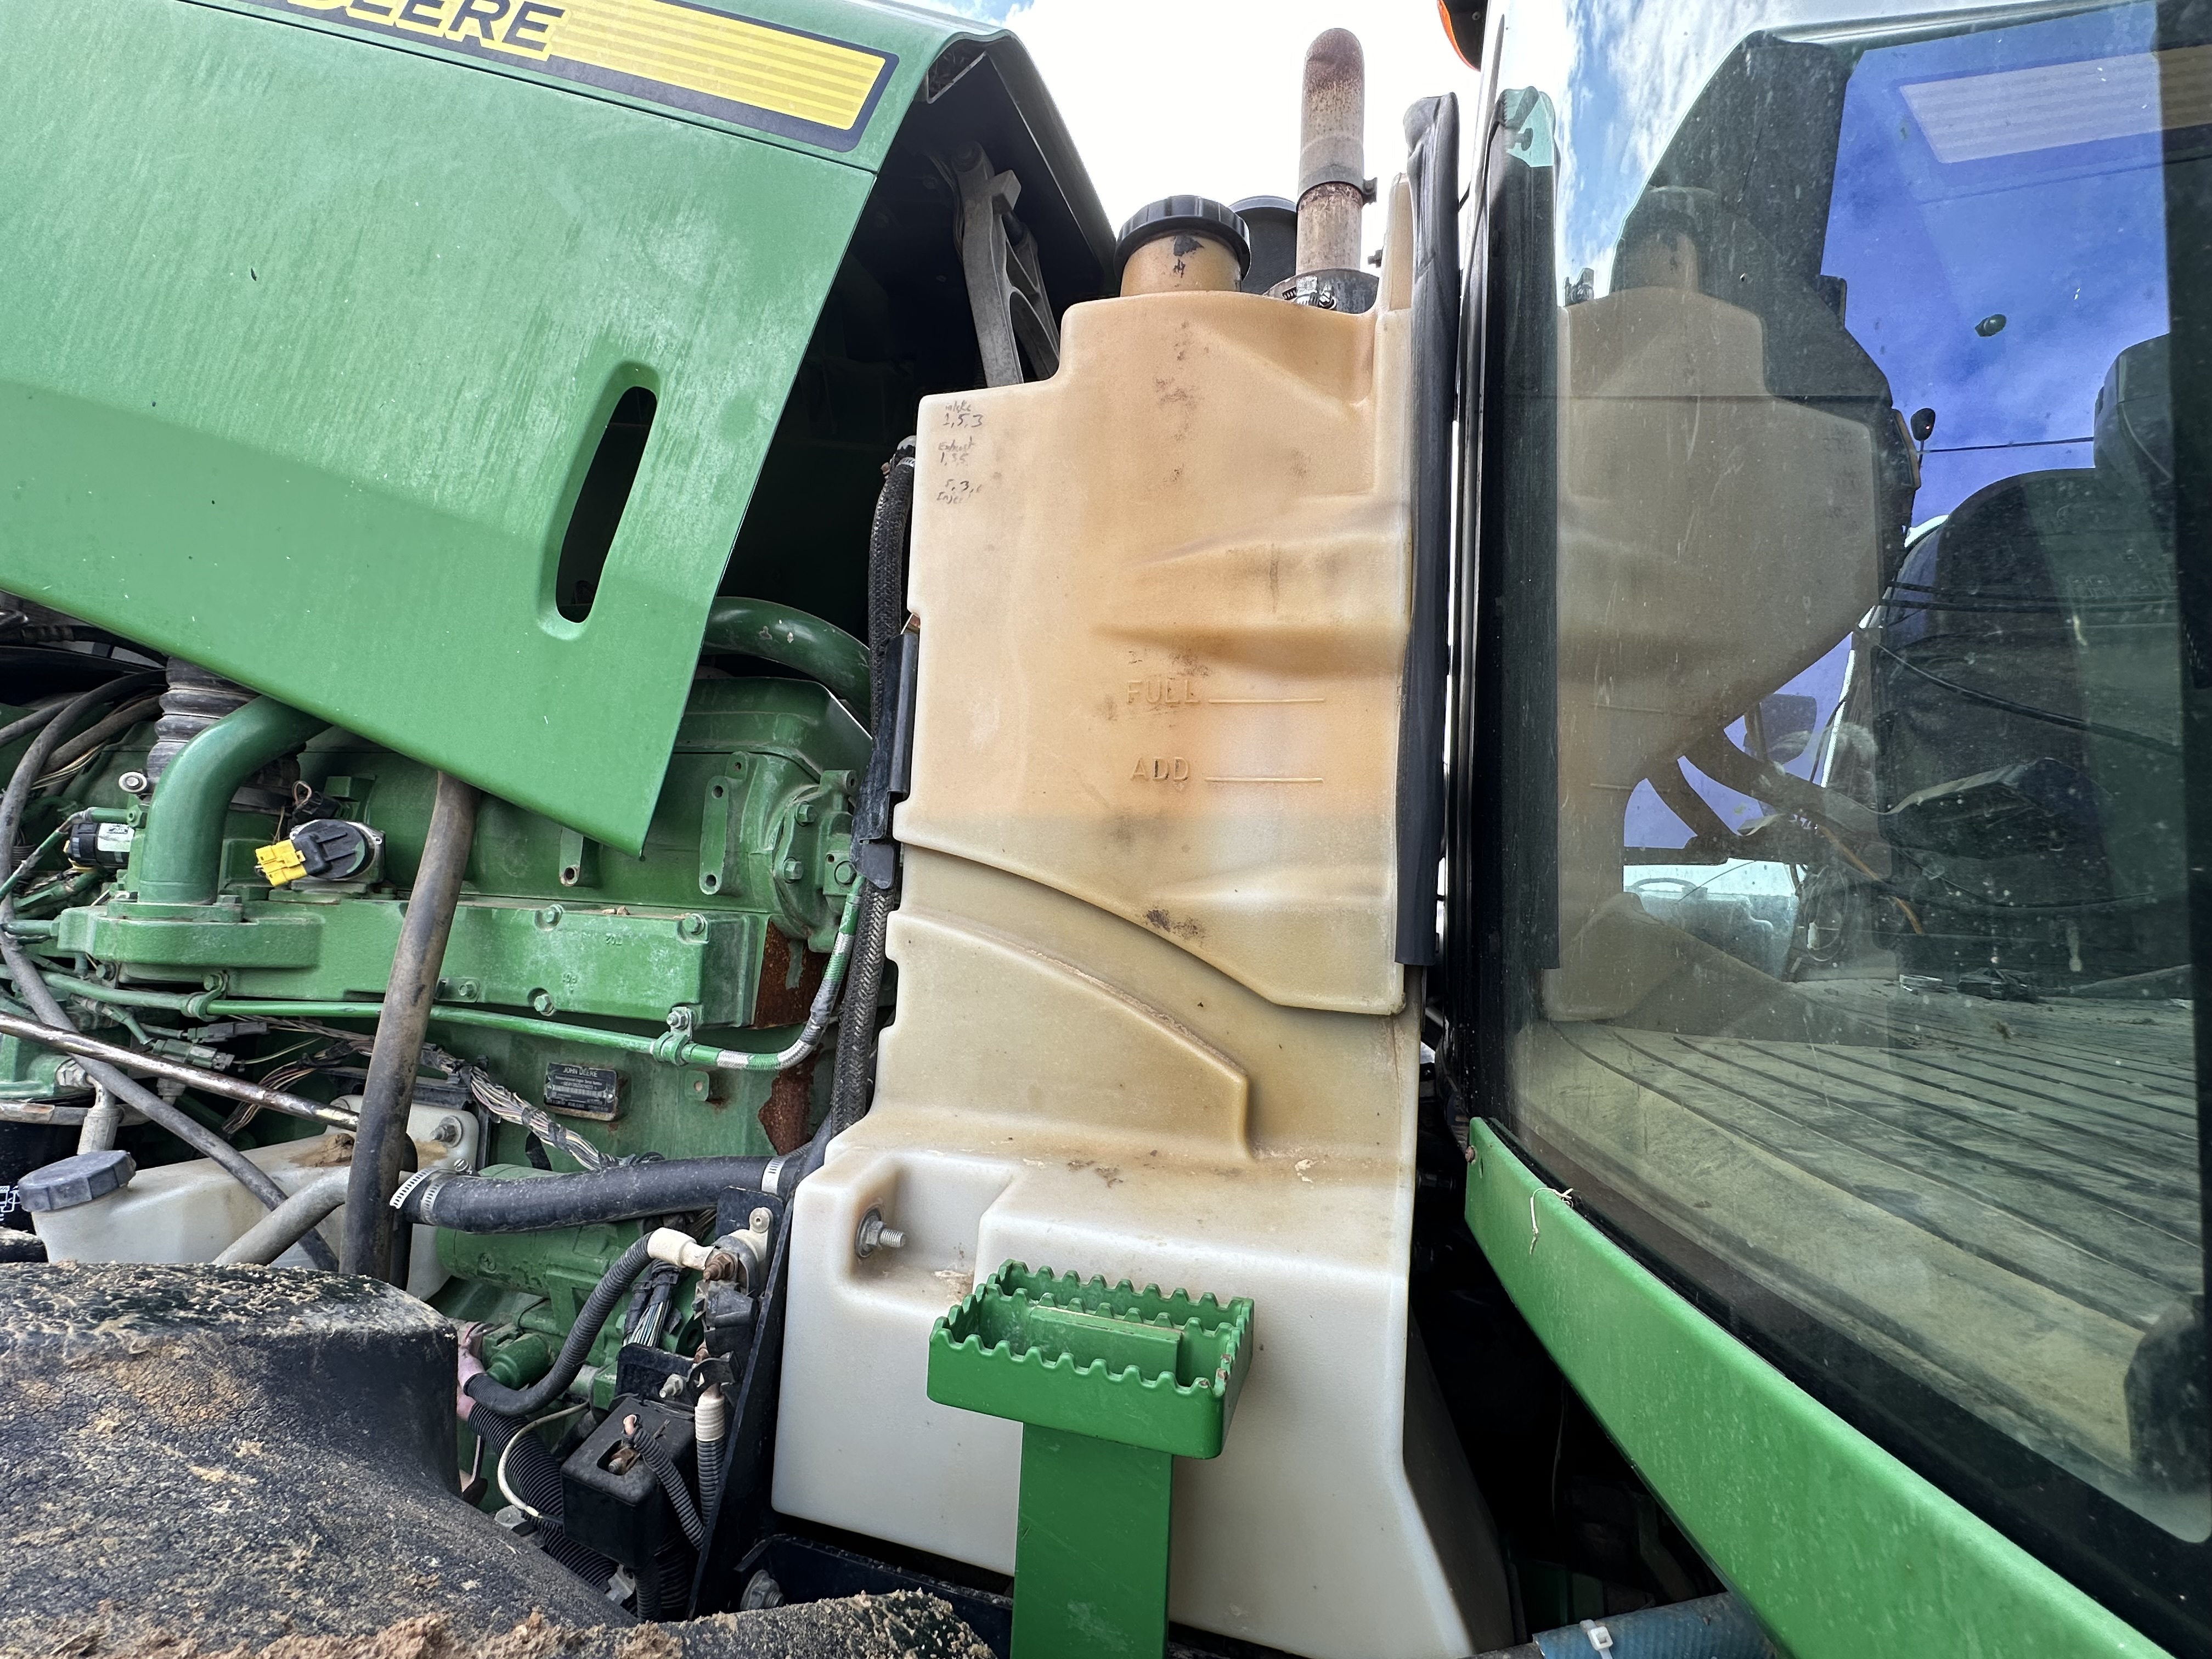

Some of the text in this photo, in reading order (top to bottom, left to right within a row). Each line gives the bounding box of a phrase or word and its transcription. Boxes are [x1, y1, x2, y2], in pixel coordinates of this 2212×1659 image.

[1126, 680, 1201, 705] FULL
[1130, 757, 1189, 782] ADD
[579, 1068, 598, 1077] DEERE
